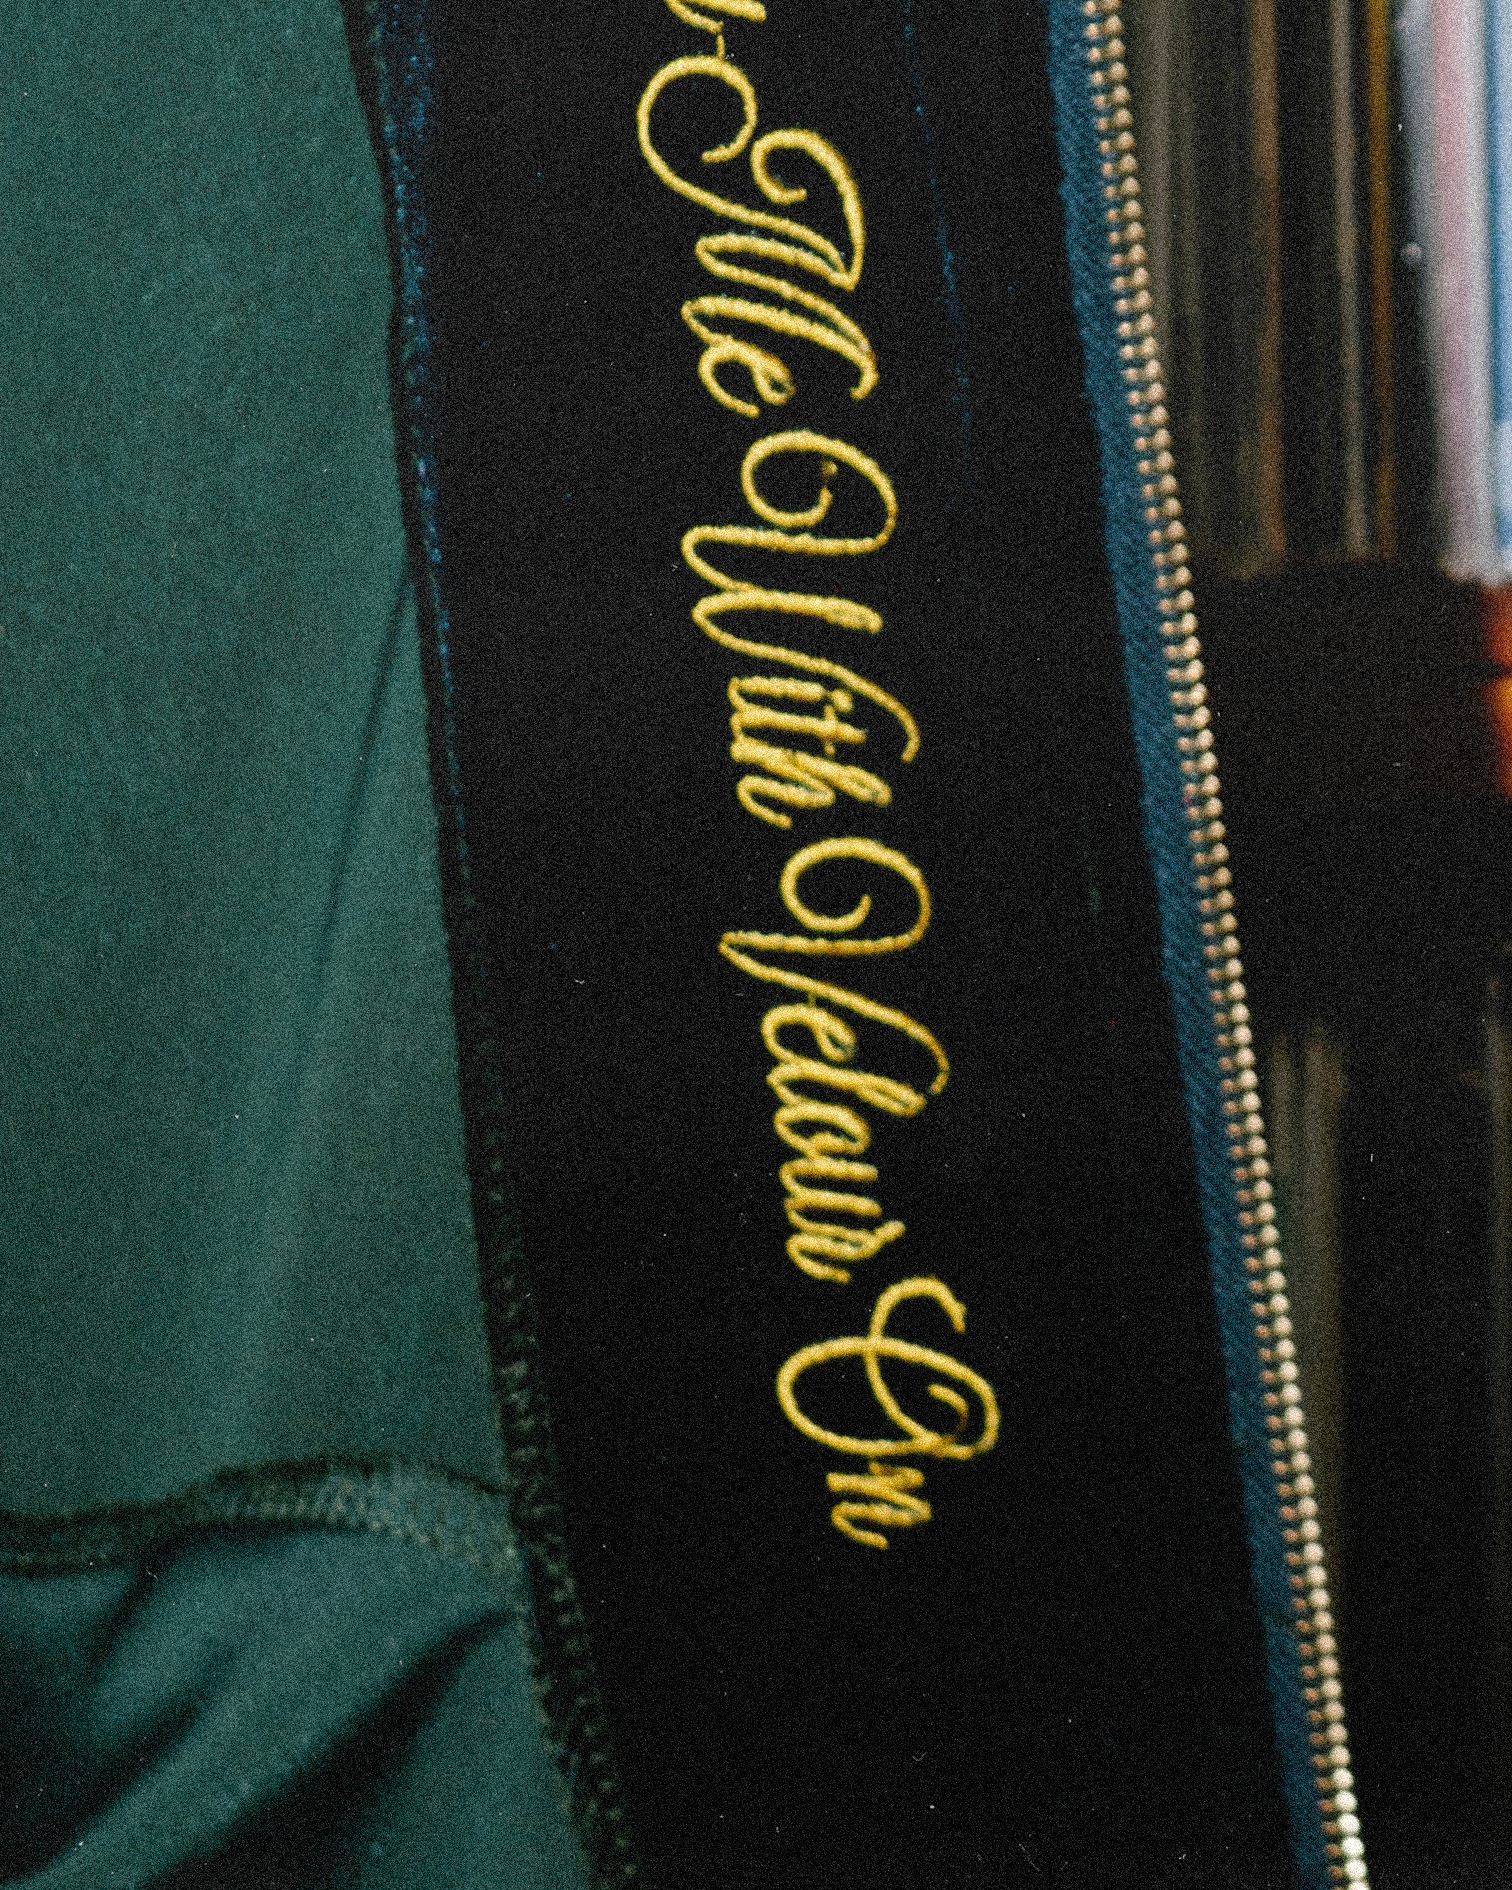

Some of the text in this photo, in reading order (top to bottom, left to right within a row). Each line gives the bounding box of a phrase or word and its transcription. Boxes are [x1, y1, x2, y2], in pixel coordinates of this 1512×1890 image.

[636, 54, 880, 418] Me
[681, 429, 920, 828] With
[719, 837, 949, 1282] Velour
[776, 1277, 1000, 1548] On
